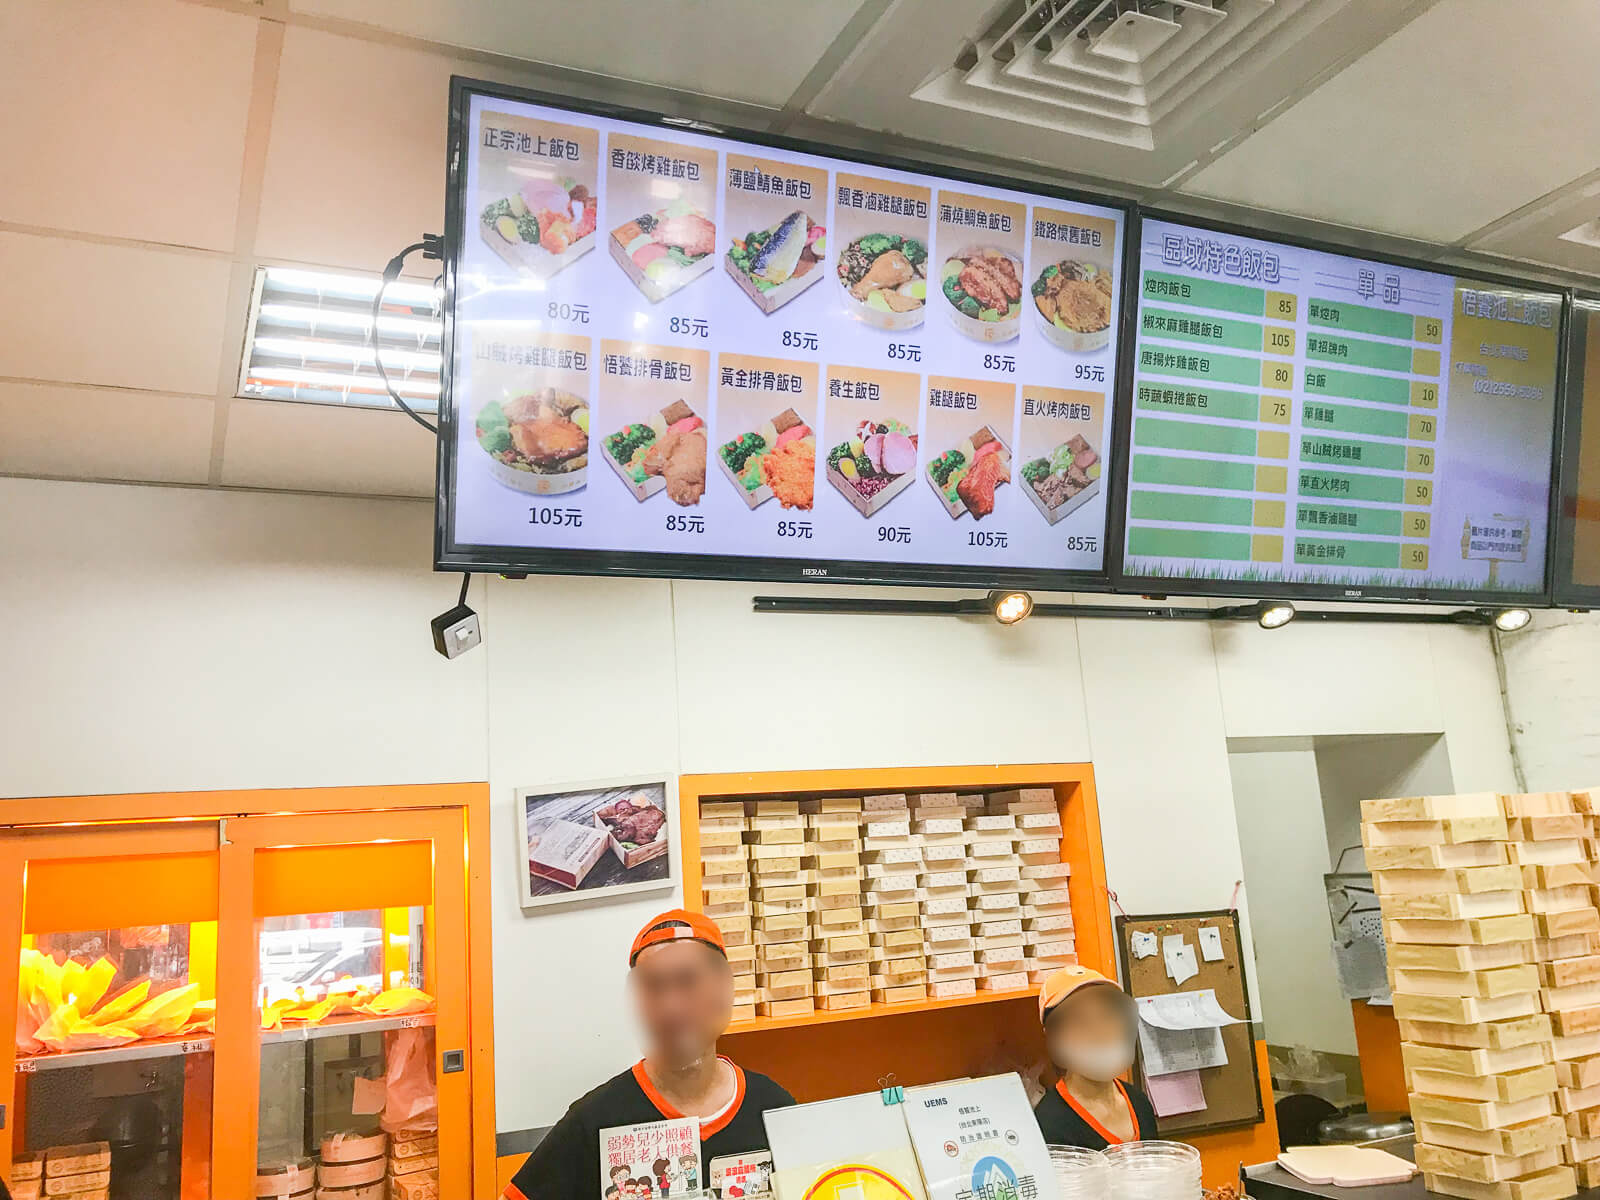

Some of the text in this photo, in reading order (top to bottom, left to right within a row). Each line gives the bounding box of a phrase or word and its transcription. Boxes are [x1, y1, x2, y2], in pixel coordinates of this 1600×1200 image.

[483, 128, 580, 161] 正宗池上飯包
[729, 168, 812, 199] 薄鹽鯖魚飯包
[838, 186, 928, 219] 飄香滷雞腿飯包
[939, 204, 1012, 232] 蒲燒鯛魚飯包
[1033, 220, 1102, 247] 鐵路懷舊飯包
[1161, 233, 1280, 283] 區域特色飯包
[1145, 277, 1291, 313] 焢肉飯包 85
[1358, 268, 1401, 304] 單品
[548, 302, 590, 323] 80元
[669, 317, 709, 338] 85元
[1426, 324, 1438, 336] 50
[782, 330, 818, 350] 85元
[1271, 333, 1290, 347] 105
[887, 343, 921, 362] 85元
[983, 354, 1016, 373] 85元
[1074, 364, 1105, 382] 95元
[1141, 351, 1288, 382] 唐揚炸雞飯包 80
[720, 367, 802, 393] 黃金排骨飯包
[829, 379, 880, 401] 養生飯包
[1306, 373, 1434, 401] 白飯 10
[930, 389, 977, 410] 雞腿飯包
[1024, 398, 1091, 421] 直火烤肉飯包
[1273, 403, 1286, 416] 75
[1421, 421, 1432, 433] 70
[1418, 454, 1430, 466] 70
[1300, 475, 1428, 498] 單直火烤肉 50
[528, 507, 583, 528] 105元
[666, 515, 705, 534] 85元
[1414, 519, 1426, 530] 50
[777, 521, 813, 539] 85元
[877, 527, 912, 544] 90元
[967, 531, 1008, 548] 105元
[1067, 536, 1098, 552] 85元
[1412, 550, 1424, 562] 50
[802, 568, 828, 577] HERAN
[924, 1097, 948, 1108] UEMS
[607, 1125, 693, 1152] 弱勢兒少照顧
